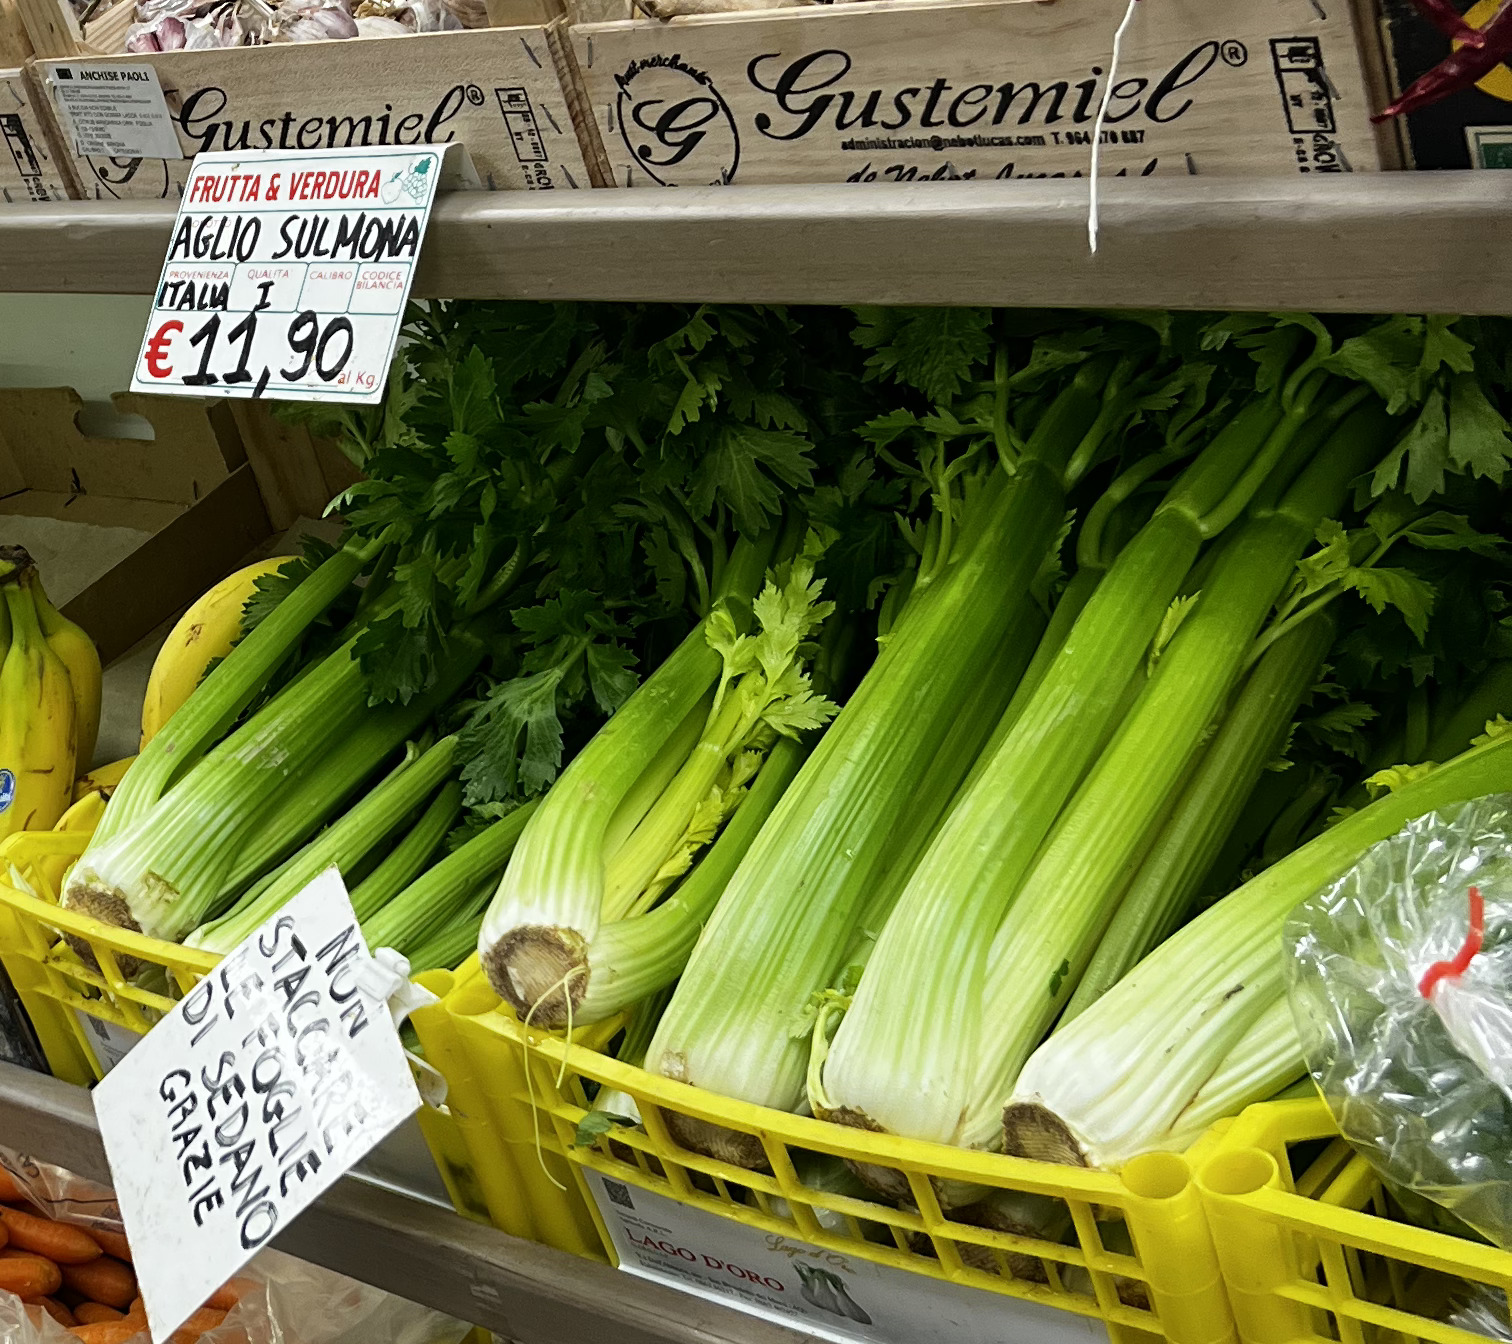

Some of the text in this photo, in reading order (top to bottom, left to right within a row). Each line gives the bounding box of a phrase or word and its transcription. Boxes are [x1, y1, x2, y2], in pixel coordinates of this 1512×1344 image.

[80, 71, 149, 82] ANCHISE PAOLI
[747, 41, 1220, 141] Gustemiel
[164, 85, 464, 154] Gustemiel
[190, 169, 381, 203] FRUTTA & VERDURA
[168, 212, 420, 263] AGLIO SULMONA
[169, 270, 229, 280] PROVENIENZA
[310, 270, 353, 281] CALIBRO
[356, 280, 404, 291] BILANCIA
[362, 270, 403, 281] CODICE
[158, 281, 230, 311] ITALIA
[338, 370, 351, 385] al
[221, 946, 322, 1197] LE FOGLIE
[182, 980, 278, 1249] DI SEDANO
[159, 1068, 225, 1227] GRAZIE
[625, 1226, 696, 1262] LAGO
[700, 1253, 785, 1292] D'ORO
